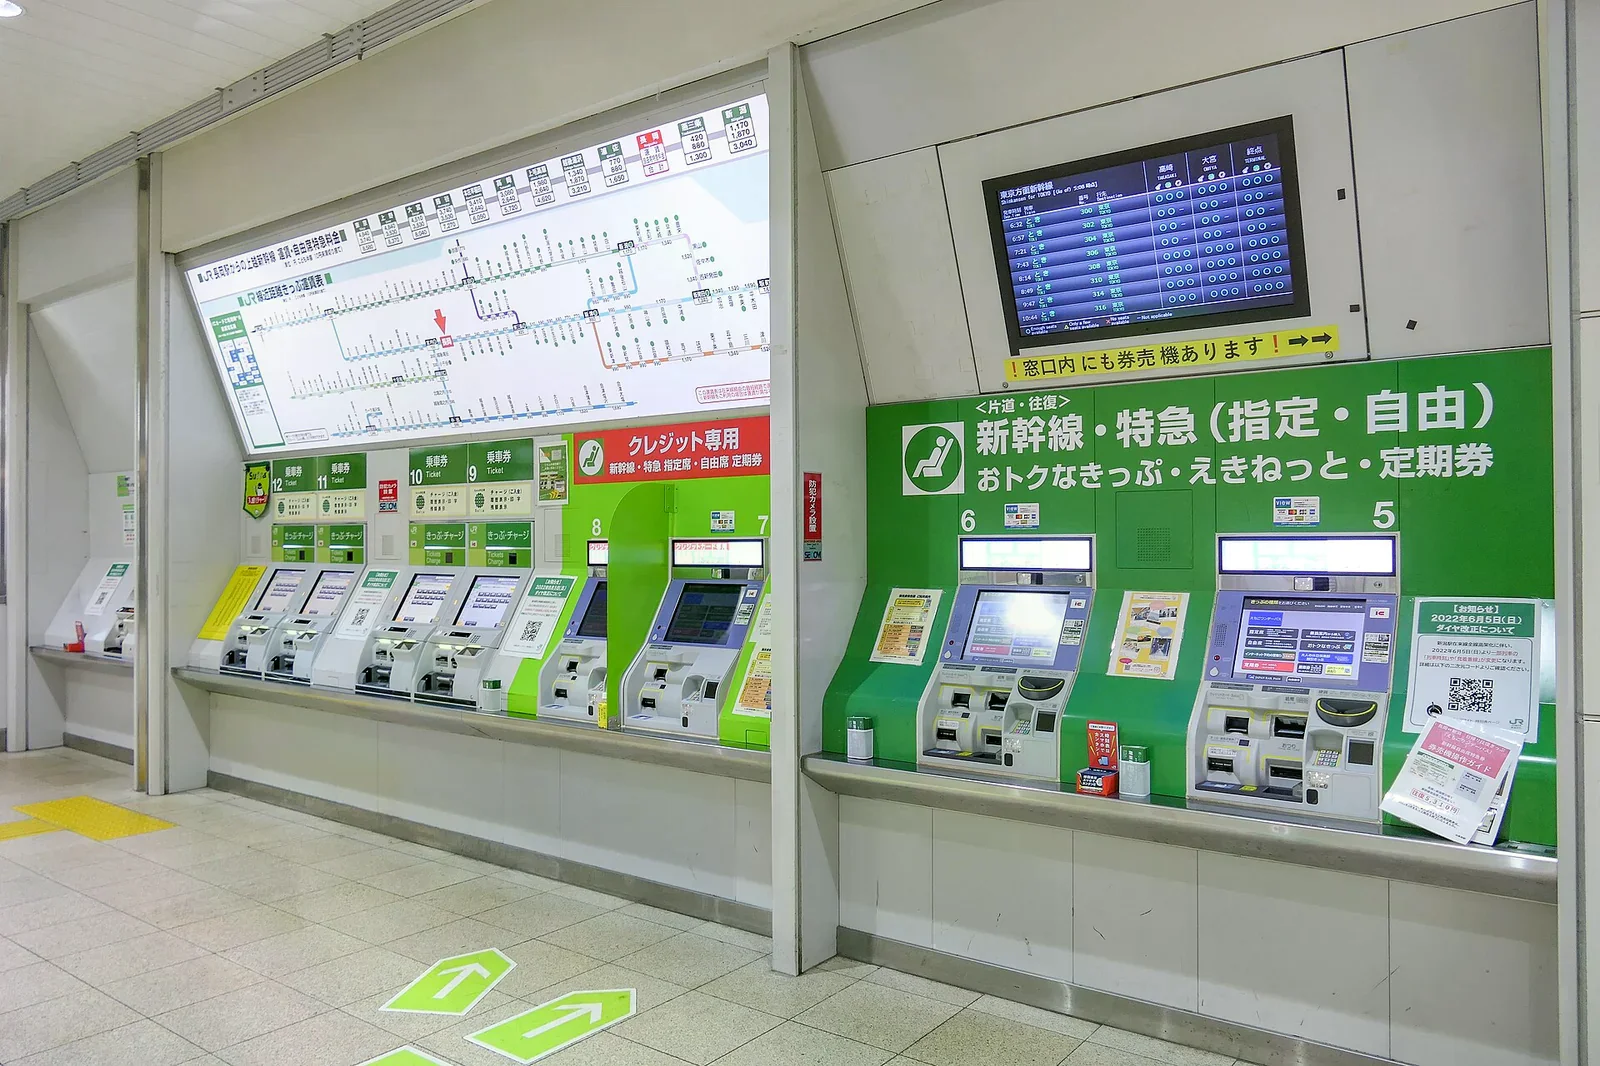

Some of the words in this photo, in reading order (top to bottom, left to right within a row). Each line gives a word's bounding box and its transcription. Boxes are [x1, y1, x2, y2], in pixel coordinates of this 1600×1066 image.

[730, 121, 749, 131] 1,170
[691, 134, 703, 142] 420
[732, 129, 750, 138] 1,870
[733, 139, 752, 150] 3,040
[690, 152, 707, 162] 1,300
[1202, 155, 1218, 164] 大宮
[568, 169, 583, 178] 1,340
[570, 176, 584, 184] 1,870
[610, 174, 625, 184] 1,650
[572, 185, 587, 194] 3,210
[1000, 181, 1054, 200] 東京方面新幹線
[537, 195, 552, 203] 4,620
[1026, 216, 1040, 225] とき
[1028, 230, 1042, 238] とき
[1030, 244, 1045, 252] とき
[1032, 256, 1047, 264] とき
[1034, 270, 1049, 278] とき
[1036, 283, 1052, 291] とき
[1039, 296, 1053, 304] とき
[1041, 310, 1056, 318] とき
[976, 382, 1494, 456] 新幹線・特急(指定・自由)
[629, 427, 739, 457] クレジット専用
[426, 454, 448, 468] 乗車券
[486, 450, 512, 464] 乗車券
[609, 460, 661, 475] 新幹線・特急
[664, 456, 729, 471] 指定席・自由席
[732, 454, 762, 467] 定期券
[977, 442, 1494, 492] おトクなきっぷ・えきねっと・定期券
[410, 469, 422, 484] 10
[469, 466, 477, 482] 9
[272, 478, 282, 492] 12
[318, 475, 328, 490] 11
[808, 480, 816, 532] 防犯カメラ設置
[1372, 501, 1395, 529] 5
[758, 516, 768, 534] 7
[961, 509, 976, 532] 6
[592, 518, 602, 536] 8
[426, 530, 464, 540] きっぷ・チャージ
[488, 530, 530, 540] きっぷ・チャージ
[1454, 605, 1499, 614] 【お知らせ】
[1431, 614, 1522, 624] 2022年6月5日(日)
[1436, 625, 1516, 634] ダイヤ改正について
[1509, 718, 1524, 726] JR
[1428, 743, 1492, 773] 券売機操作ガイド
